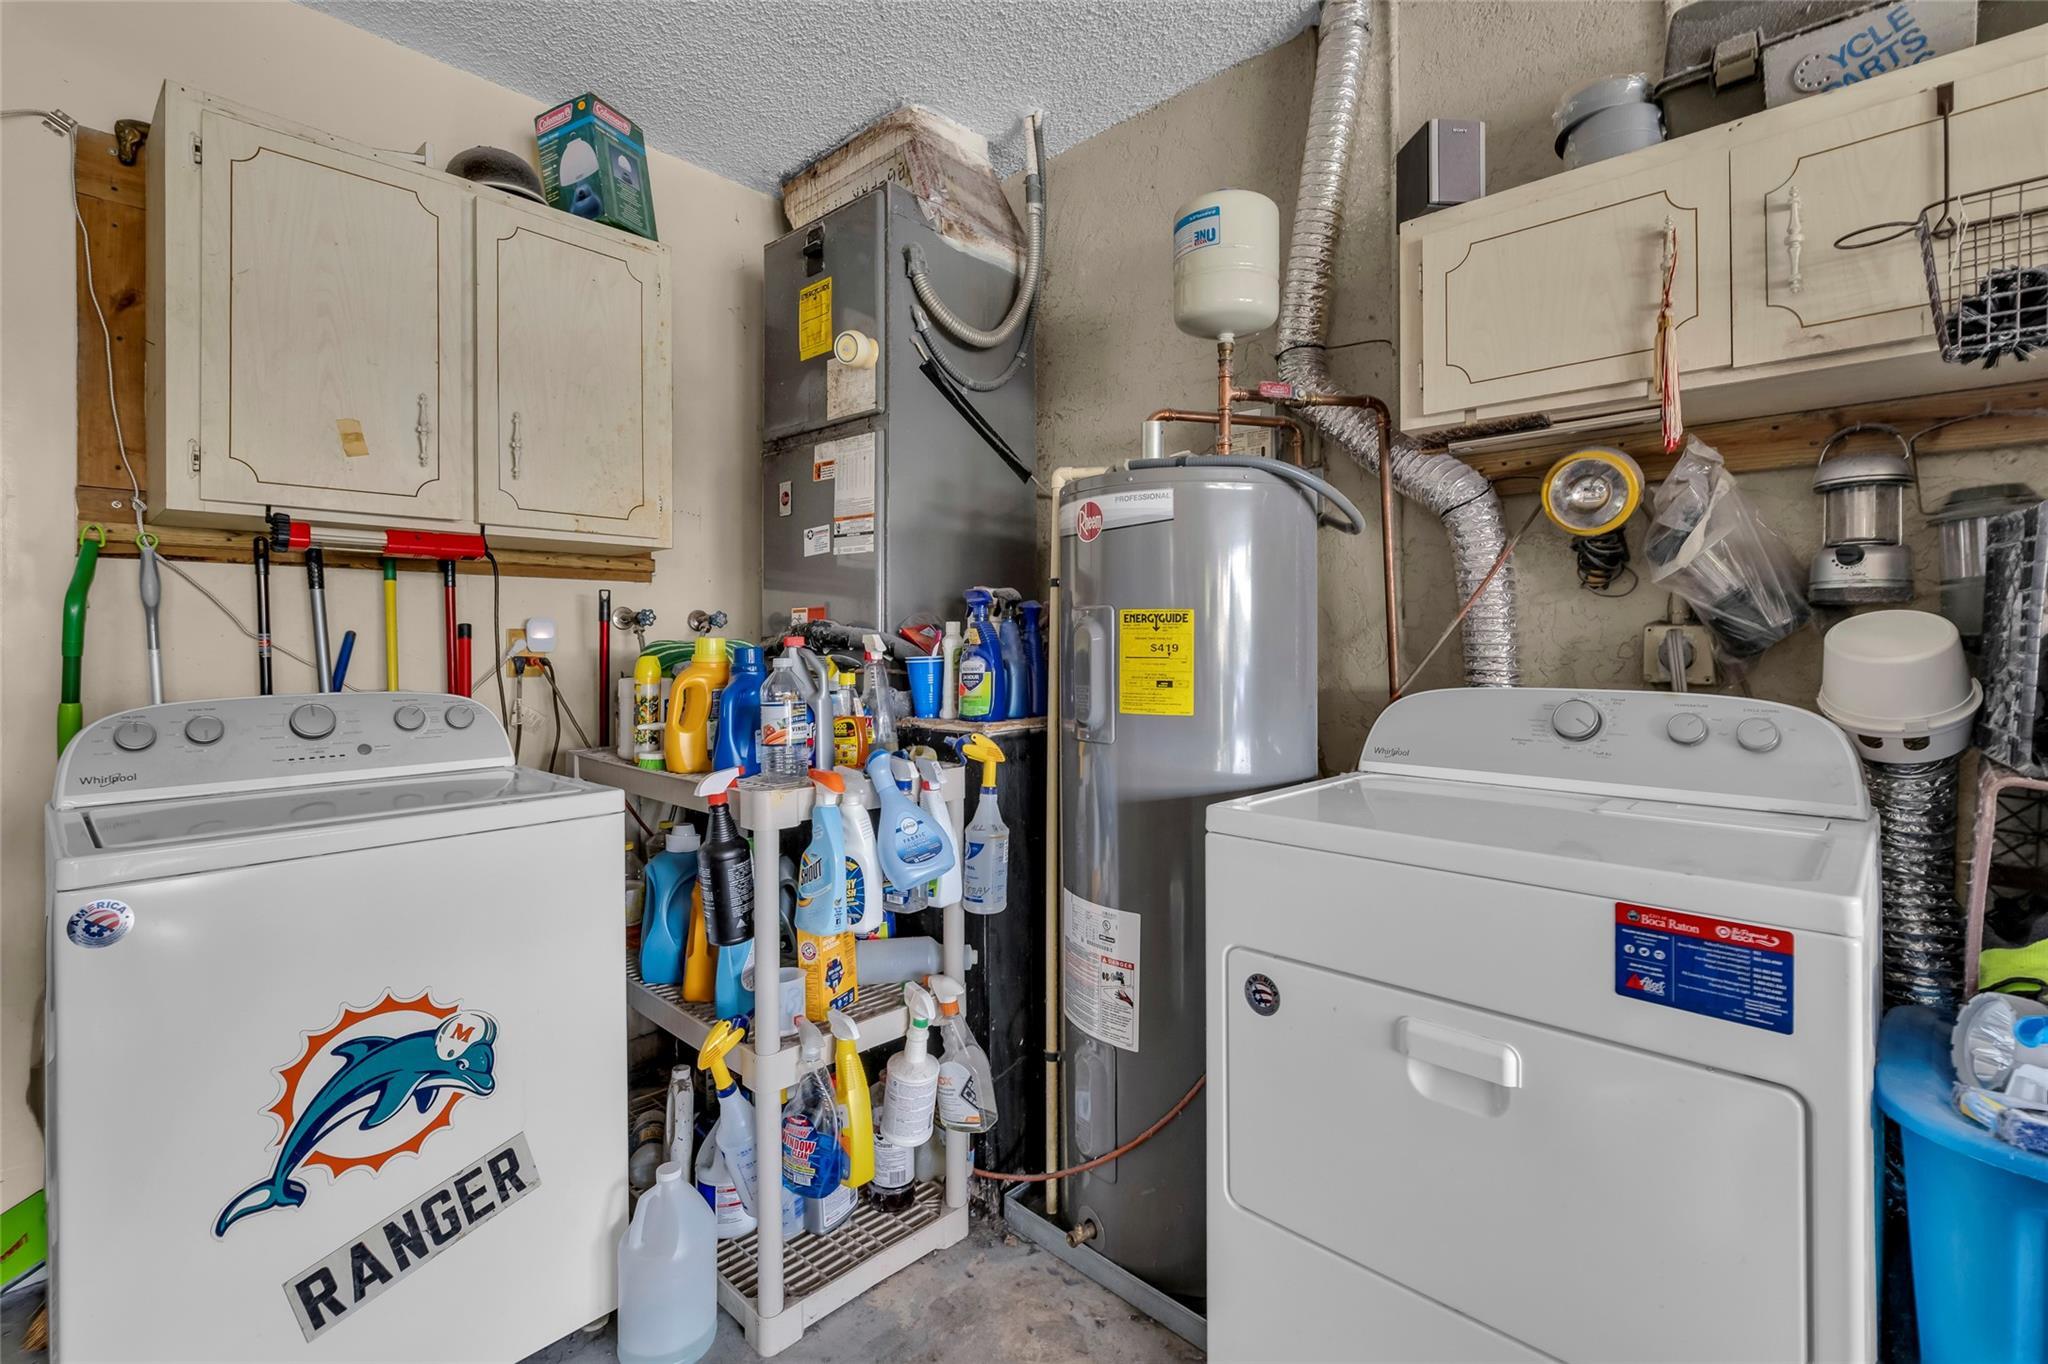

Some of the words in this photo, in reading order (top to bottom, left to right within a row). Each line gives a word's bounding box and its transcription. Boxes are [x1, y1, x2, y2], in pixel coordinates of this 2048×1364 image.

[539, 111, 565, 130] Coleman
[1115, 492, 1170, 503] PROFESSIONAL
[1080, 503, 1102, 536] Rheem
[1123, 613, 1189, 624] ENERGYGUIDE
[1374, 746, 1410, 758] Whirlpool
[79, 773, 137, 787] Whirlpool
[1641, 914, 1666, 928] Boca
[1668, 919, 1700, 934] Raton
[1107, 959, 1133, 969] DANGER
[450, 1022, 476, 1043] M
[783, 1130, 816, 1155] WINDOW
[294, 1147, 527, 1331] RANGER
